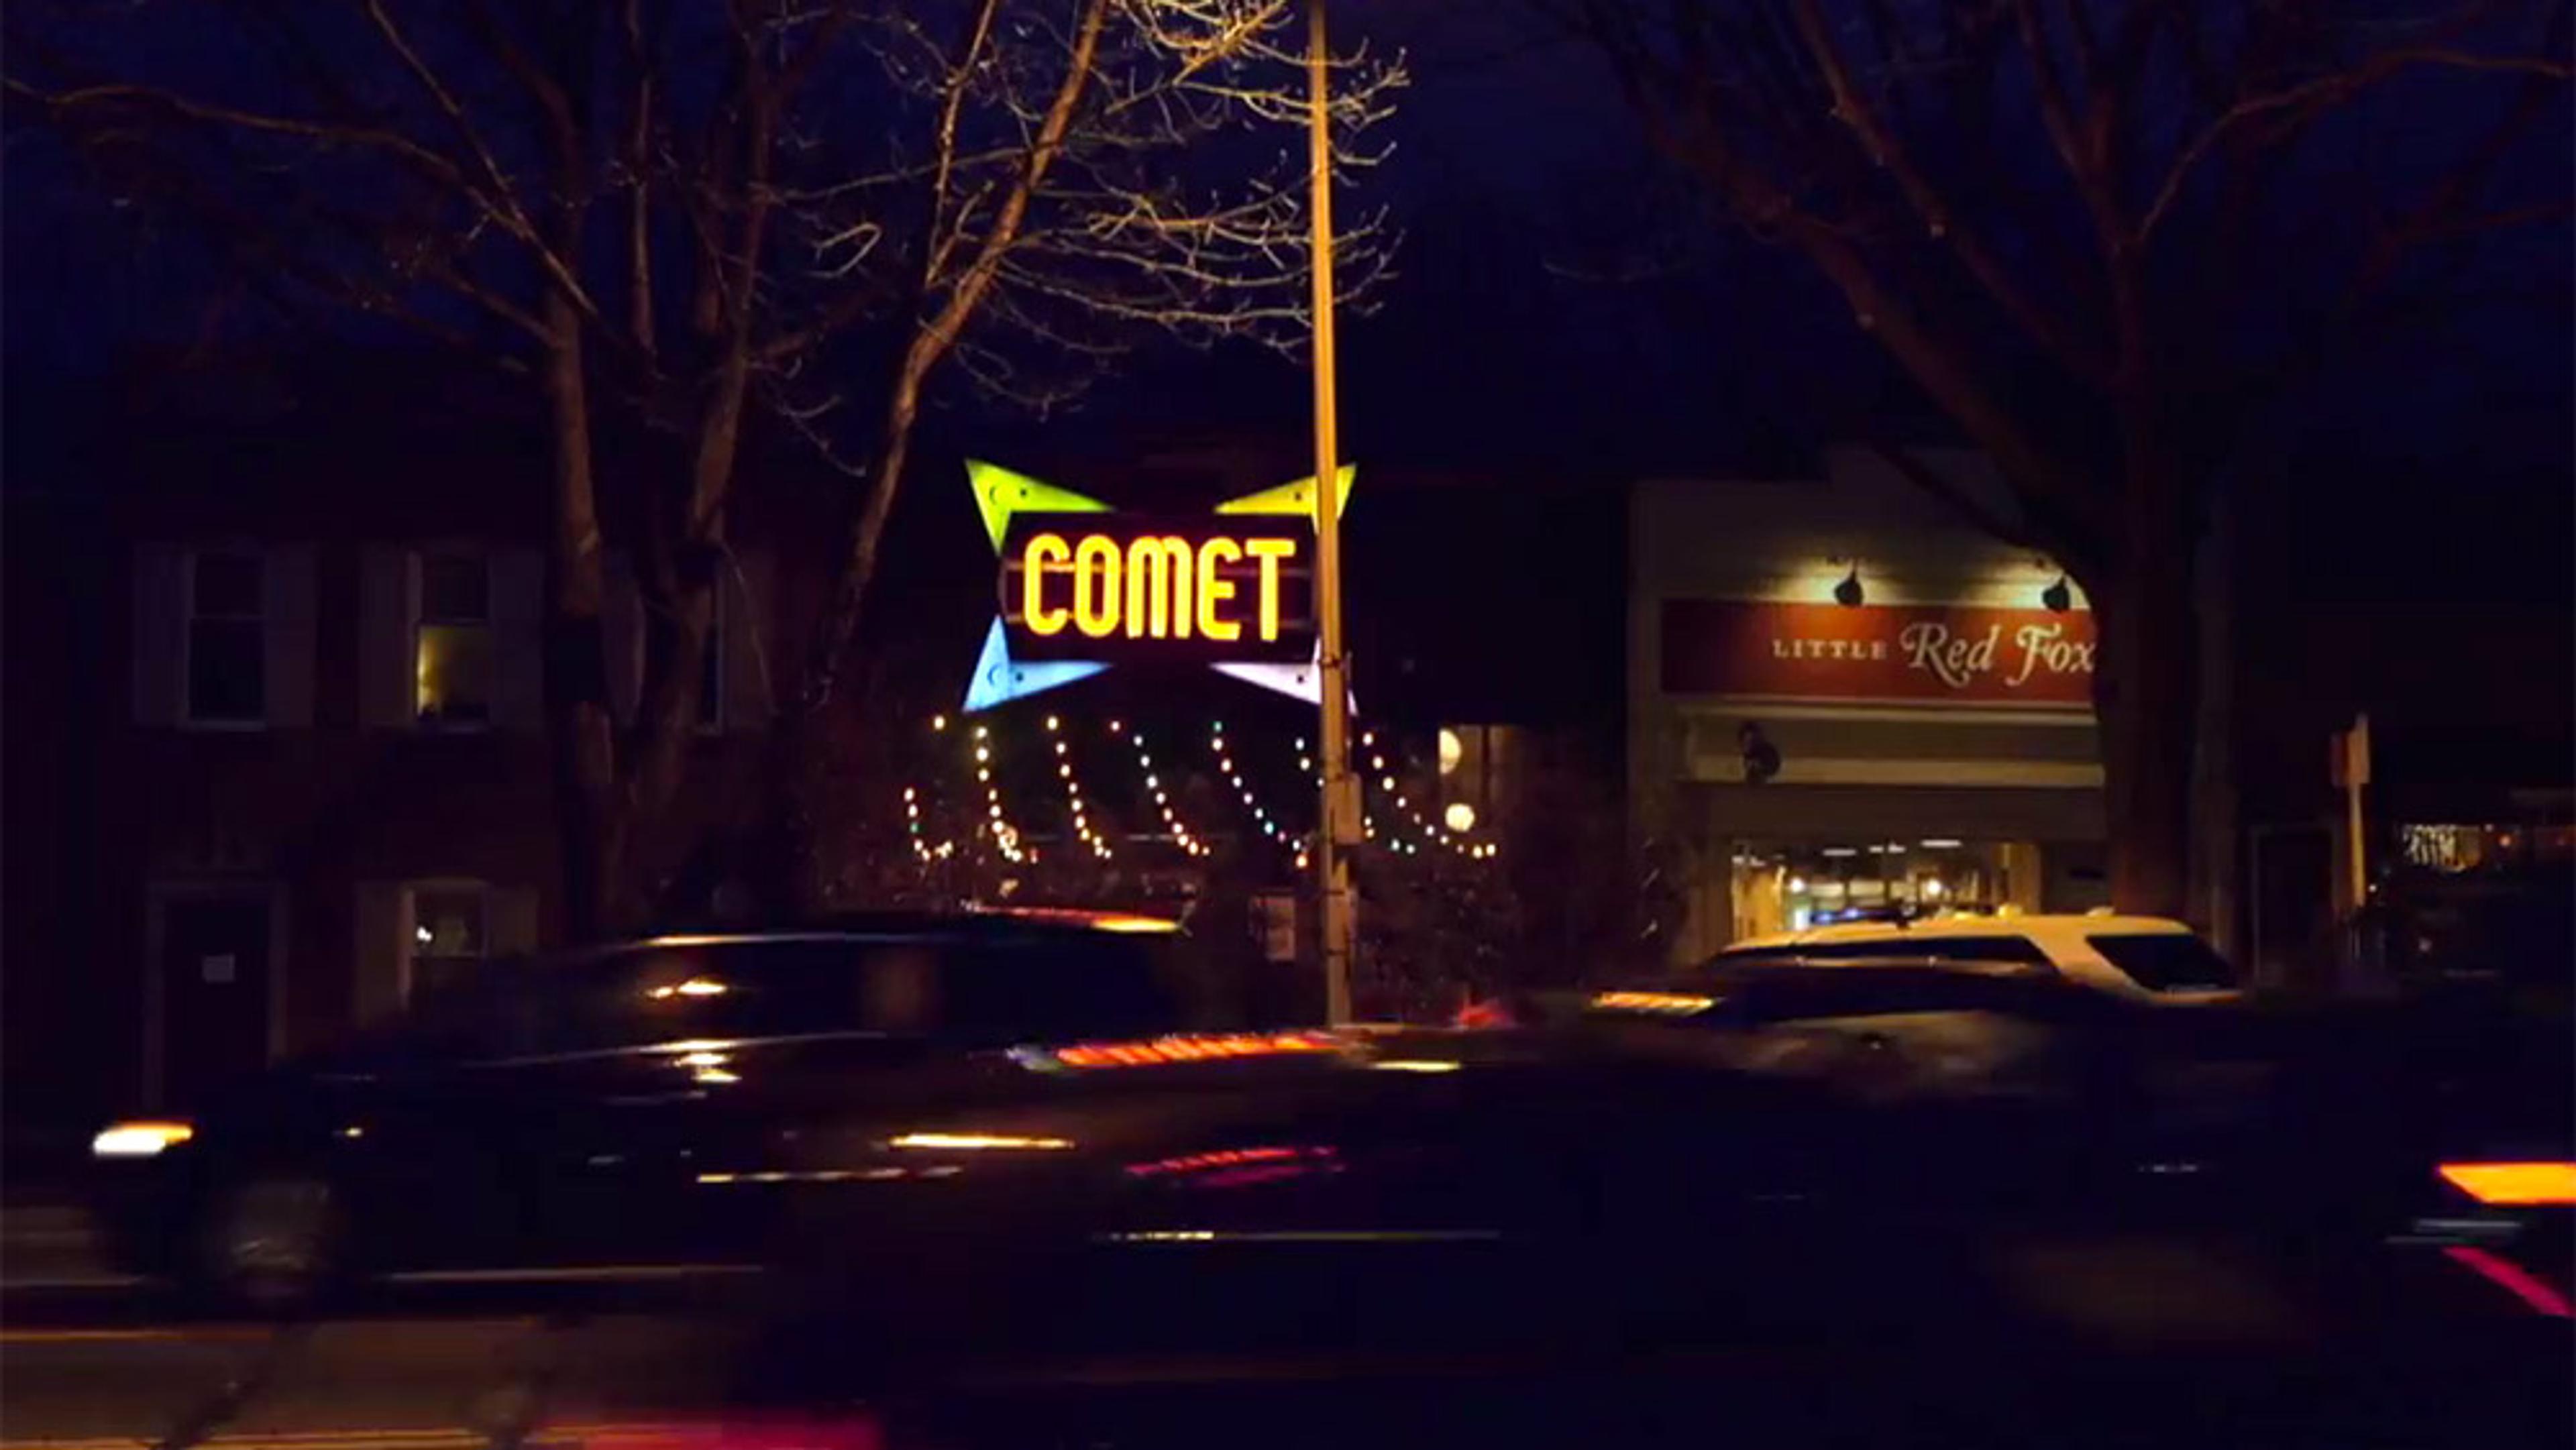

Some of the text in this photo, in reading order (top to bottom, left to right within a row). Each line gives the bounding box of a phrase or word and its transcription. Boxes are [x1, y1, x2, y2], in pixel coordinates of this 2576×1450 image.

[1024, 534, 1295, 641] COMET
[1773, 623, 2097, 687] LITTLE Red Fox
